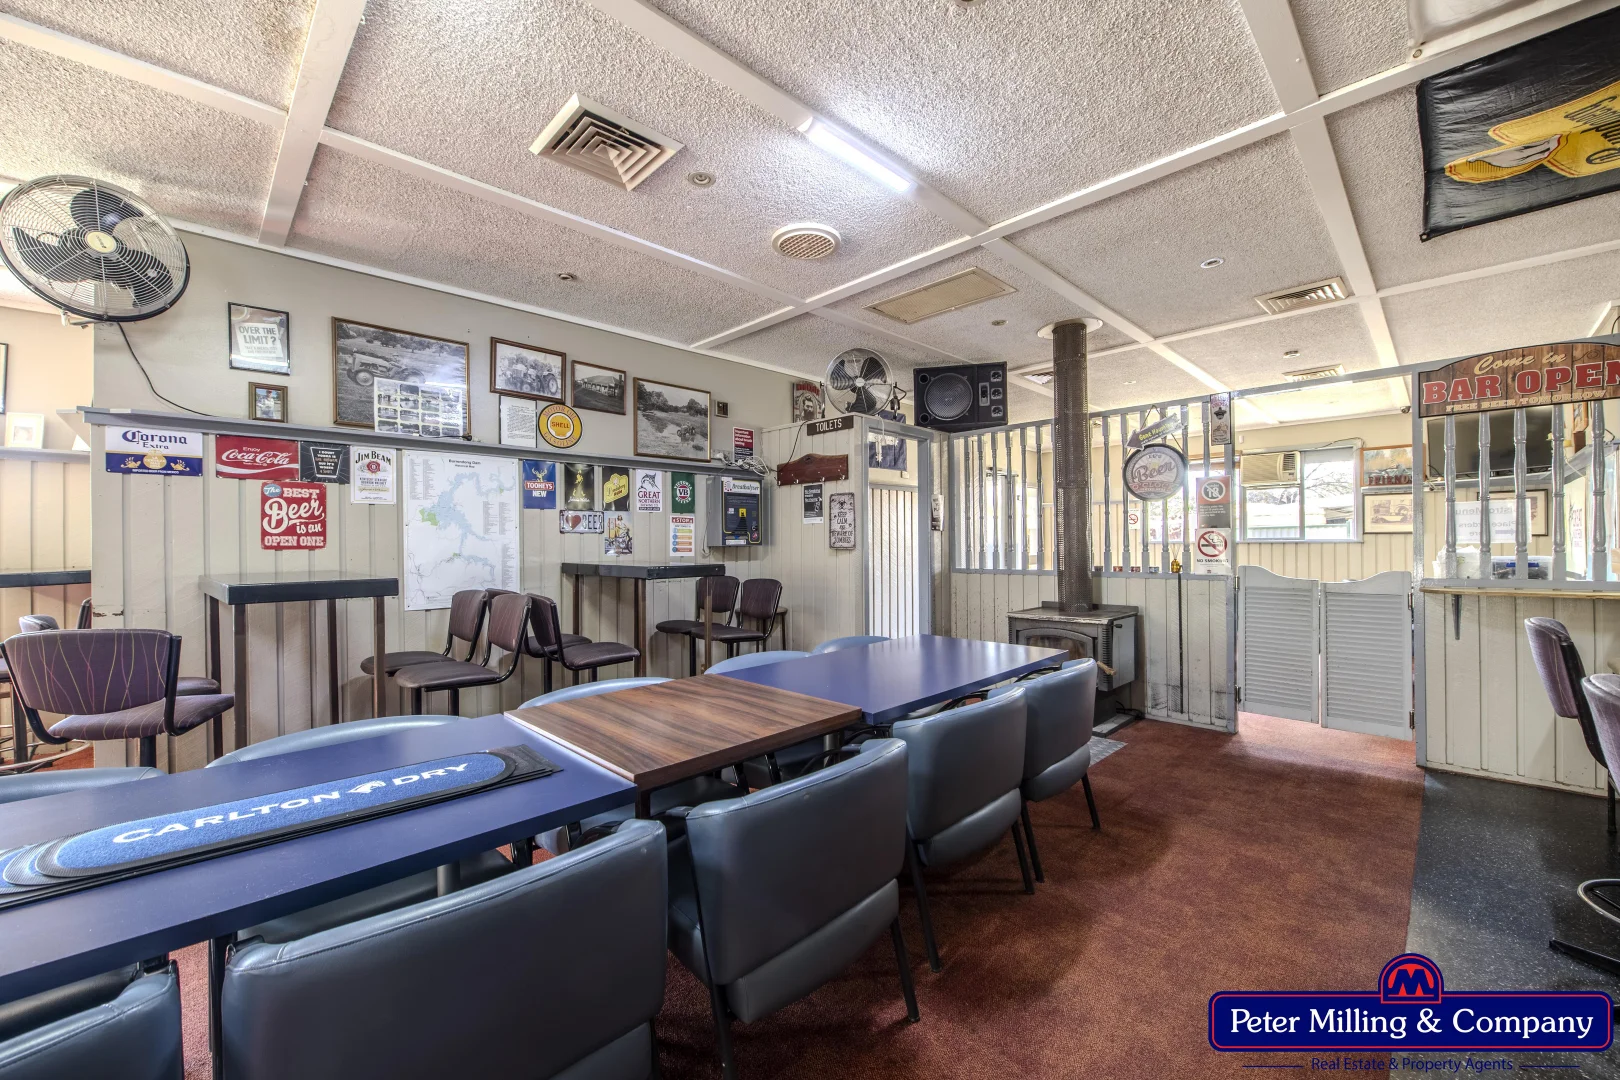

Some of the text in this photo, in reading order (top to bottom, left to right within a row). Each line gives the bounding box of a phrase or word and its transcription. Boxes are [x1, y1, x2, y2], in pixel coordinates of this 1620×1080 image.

[239, 326, 260, 335] OVER
[243, 335, 277, 345] LIMIT ?
[1474, 352, 1567, 375] Come in
[1422, 375, 1502, 405] BAR
[1446, 390, 1607, 412] FREE BEER TOMORROW
[543, 406, 577, 419] MOTOR OIL
[551, 421, 570, 429] SHELL
[816, 418, 842, 432] TOILETS
[121, 429, 188, 445] Corona
[543, 431, 577, 447] GASOLINE
[143, 441, 169, 450] Extra
[222, 448, 292, 465] Coca-Cola
[355, 450, 392, 466] JIM BEAM
[1131, 461, 1176, 483] Beer
[263, 486, 280, 495] The
[526, 482, 553, 490] TOOHEYS
[673, 480, 693, 489] VICTORIA
[282, 487, 320, 499] BEST
[532, 489, 547, 498] NEW
[637, 490, 661, 499] GREAT
[678, 488, 689, 496] VB
[1206, 487, 1220, 498] 18
[262, 497, 323, 534] Beer
[296, 522, 324, 534] is an
[582, 514, 603, 530] BEER
[264, 535, 324, 547] OPEN ONE
[112, 762, 469, 844] CARLTON DRY
